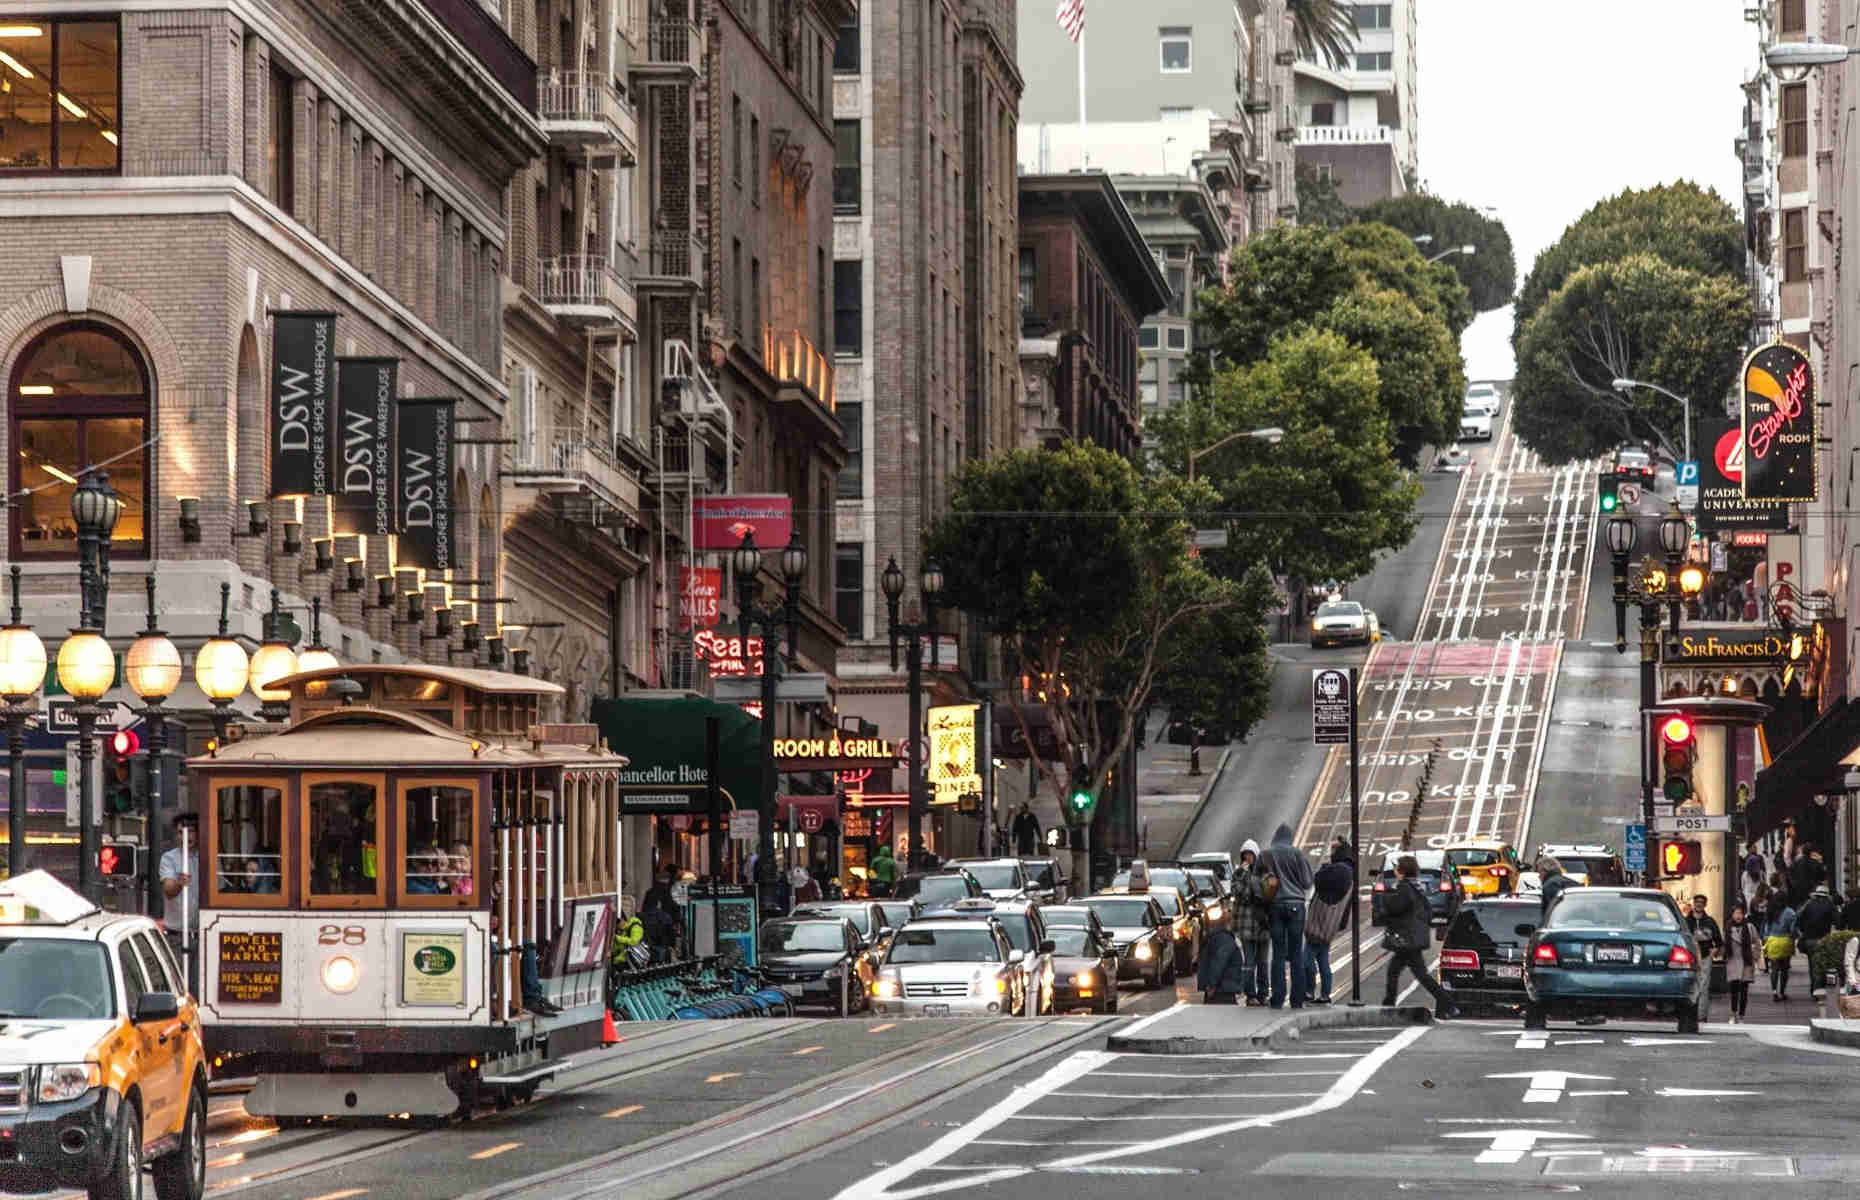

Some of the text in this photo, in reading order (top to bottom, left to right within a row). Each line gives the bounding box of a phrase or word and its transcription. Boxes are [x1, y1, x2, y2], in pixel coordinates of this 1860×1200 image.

[280, 365, 310, 452] DSW
[312, 320, 327, 496] DESIGNER SHOE WAREHOUSE
[1750, 403, 1770, 412] THE
[1779, 434, 1810, 443] ROOM
[344, 409, 373, 495] DSW
[376, 367, 390, 535] DESIGNER SHOE WAREHOUSE
[405, 448, 433, 529] DSW
[436, 407, 449, 569] DESIGNER SHOE WAREHOUSE
[681, 599, 716, 617] NAILS
[773, 739, 893, 757] ROOM & GRILL
[619, 764, 708, 783] ancellor Hote
[935, 781, 975, 793] DINER
[1676, 819, 1709, 829] POST
[223, 935, 280, 945] POWELL
[318, 924, 366, 945] 28
[222, 951, 280, 961] MARKET
